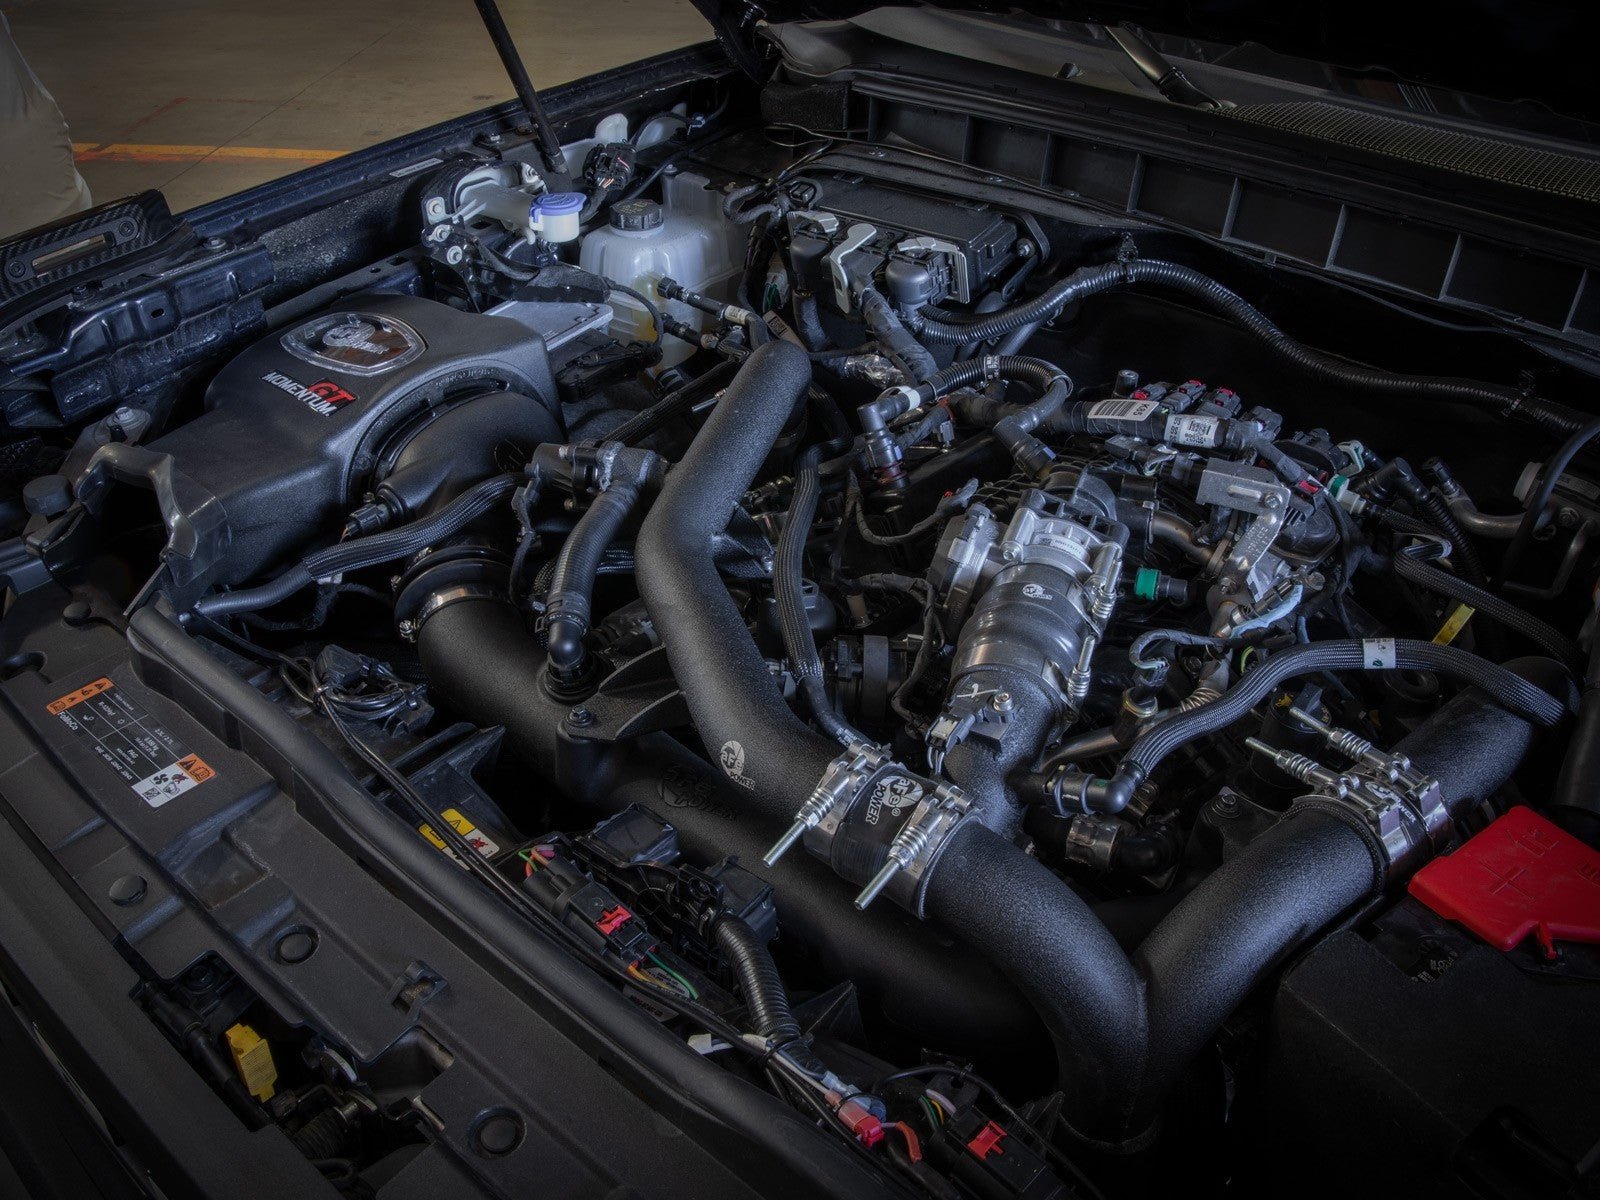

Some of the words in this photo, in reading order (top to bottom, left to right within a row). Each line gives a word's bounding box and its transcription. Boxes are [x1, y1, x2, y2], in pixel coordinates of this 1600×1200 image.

[262, 372, 338, 417] MOMENTUM
[308, 381, 357, 404] GT
[57, 711, 79, 731] FoMoCo
[729, 771, 755, 791] POWER
[865, 781, 888, 825] POWER
